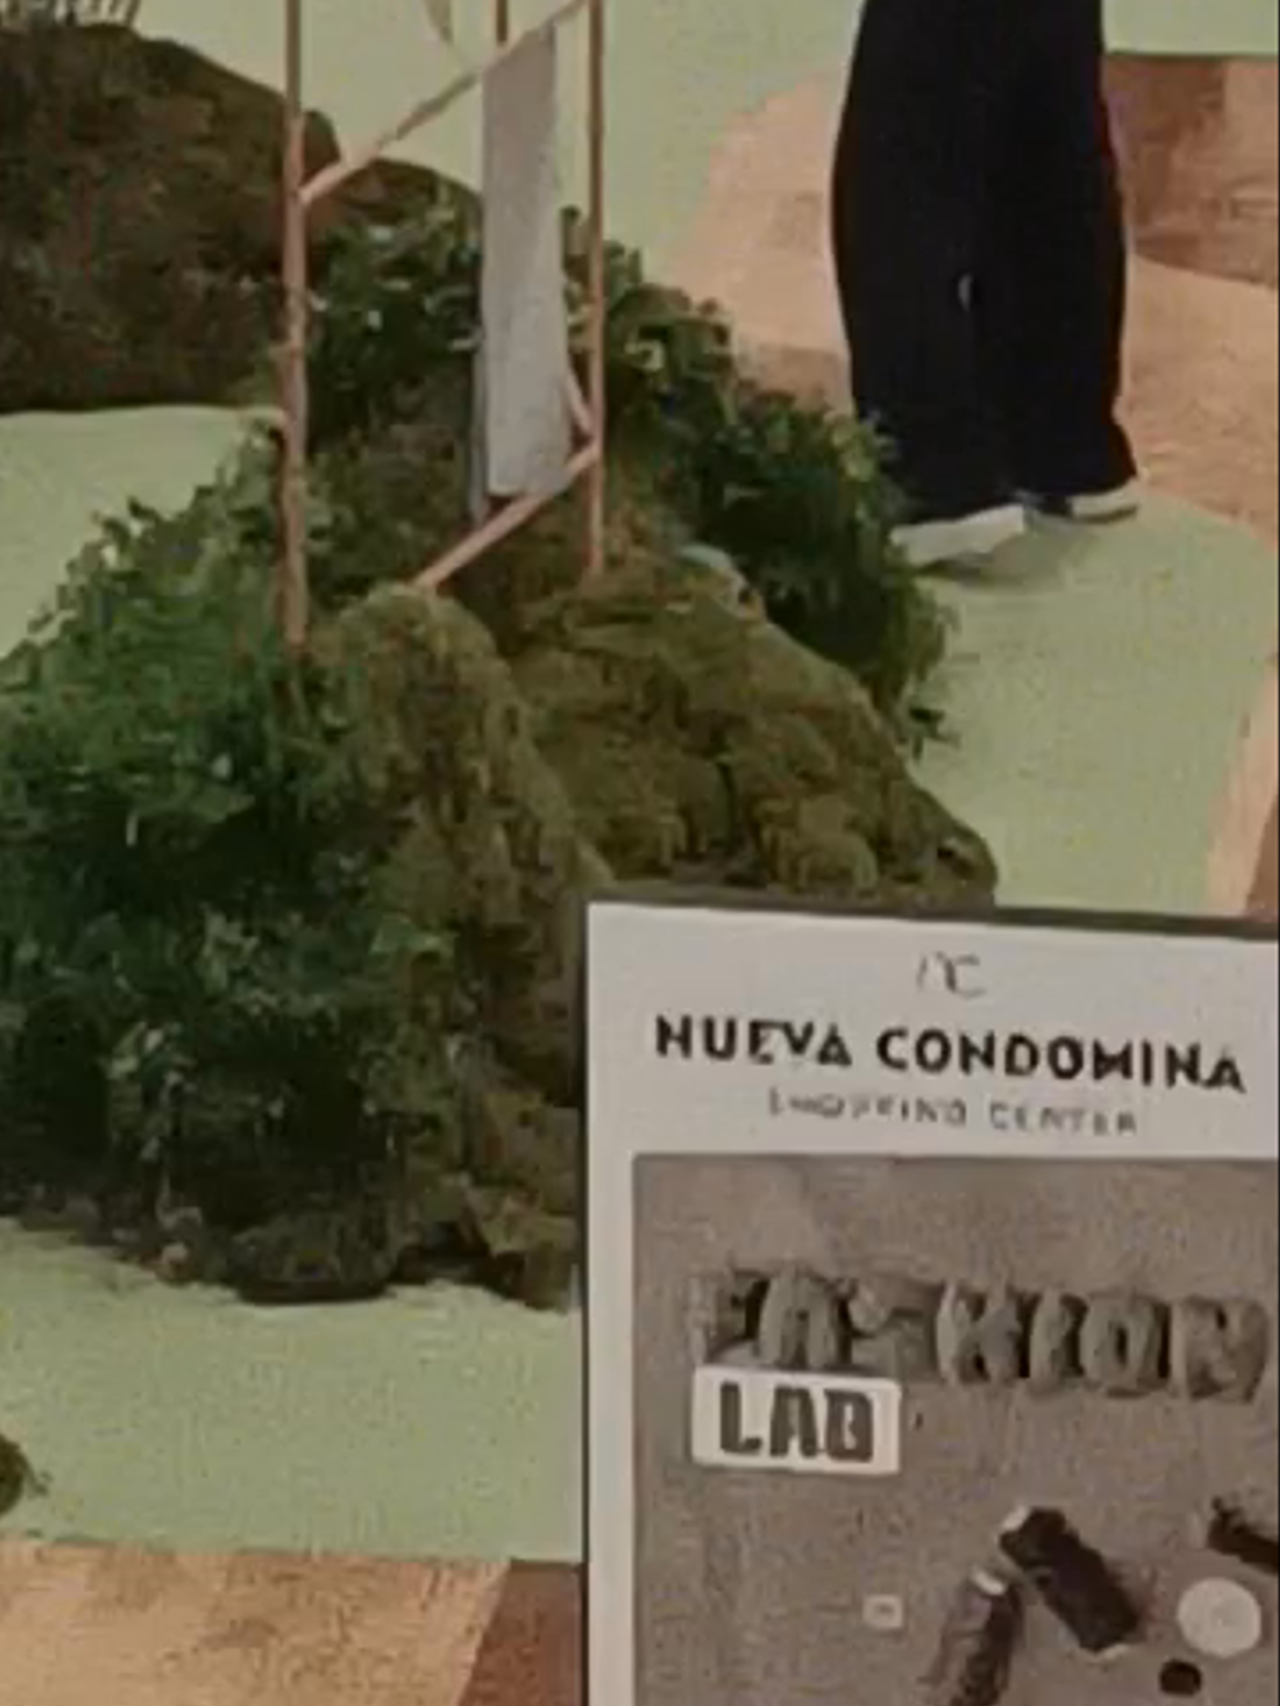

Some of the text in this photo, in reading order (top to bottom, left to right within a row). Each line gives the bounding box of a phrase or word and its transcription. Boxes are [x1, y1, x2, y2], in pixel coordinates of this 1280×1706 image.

[655, 1014, 1247, 1094] NUEVA CONDOMINA
[989, 1100, 1138, 1135] CENTER
[690, 1266, 1270, 1404] FASHION
[719, 1382, 876, 1463] LAB
